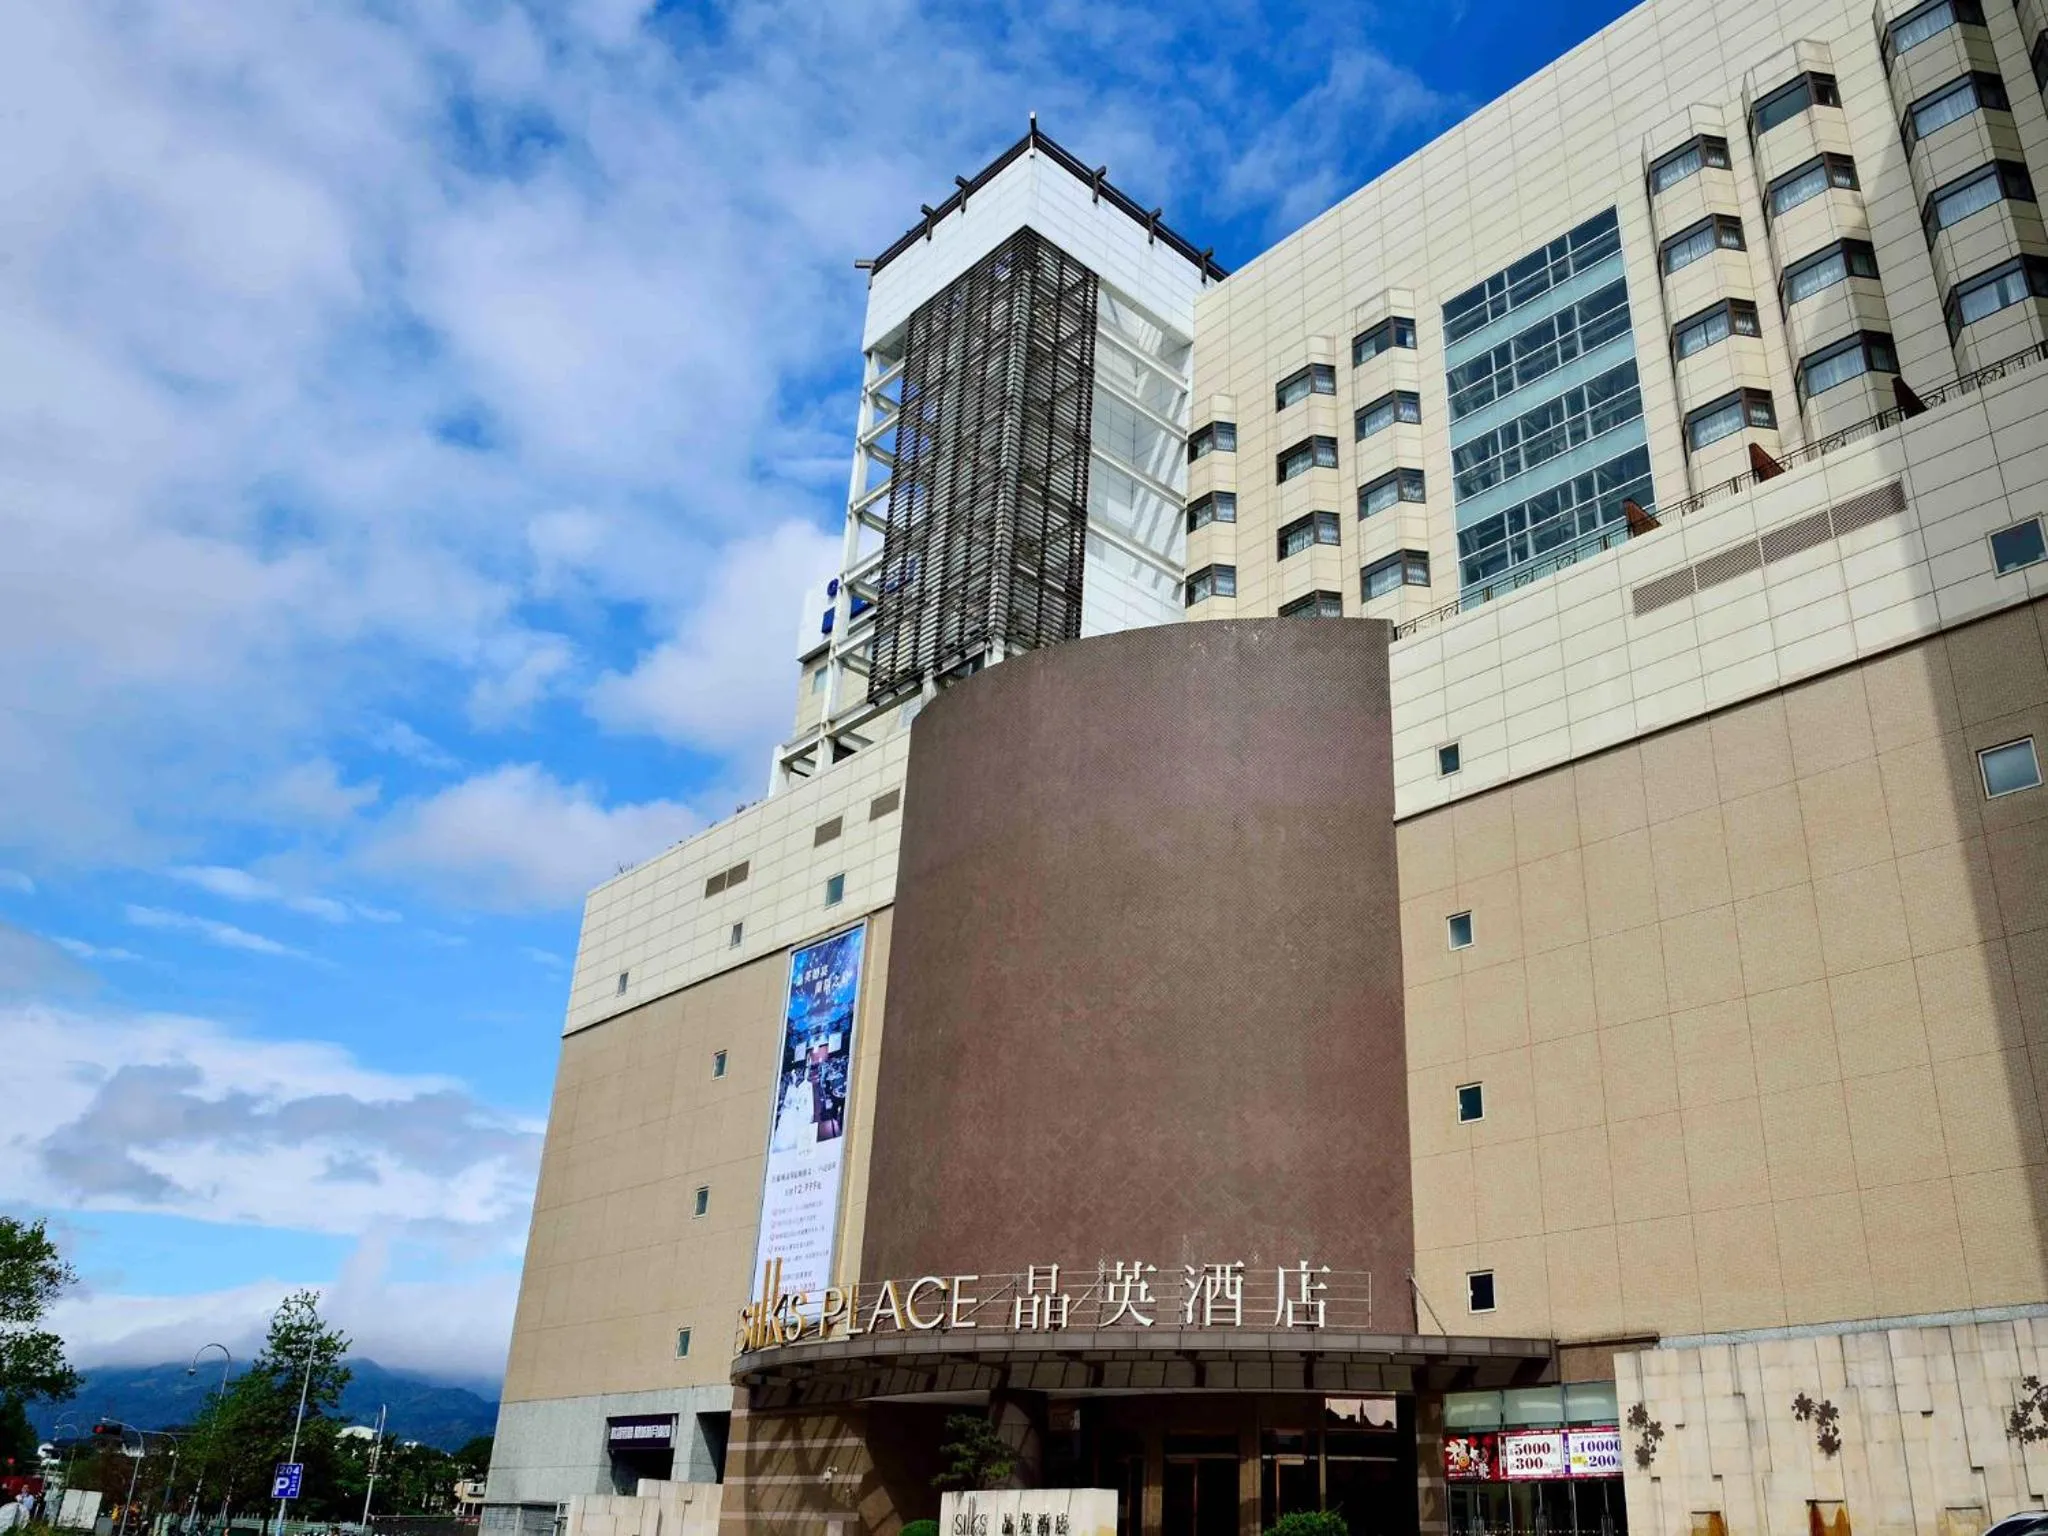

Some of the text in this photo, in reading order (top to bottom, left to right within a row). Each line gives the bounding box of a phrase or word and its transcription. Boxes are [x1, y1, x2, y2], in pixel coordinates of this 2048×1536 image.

[1014, 1260, 1331, 1329] 晶英酒店
[819, 1275, 980, 1337] PLACE
[1514, 1441, 1550, 1456] 5000
[1516, 1457, 1543, 1470] 300
[1589, 1454, 1615, 1468] 200
[279, 1466, 300, 1475] 204
[274, 1477, 290, 1495] P
